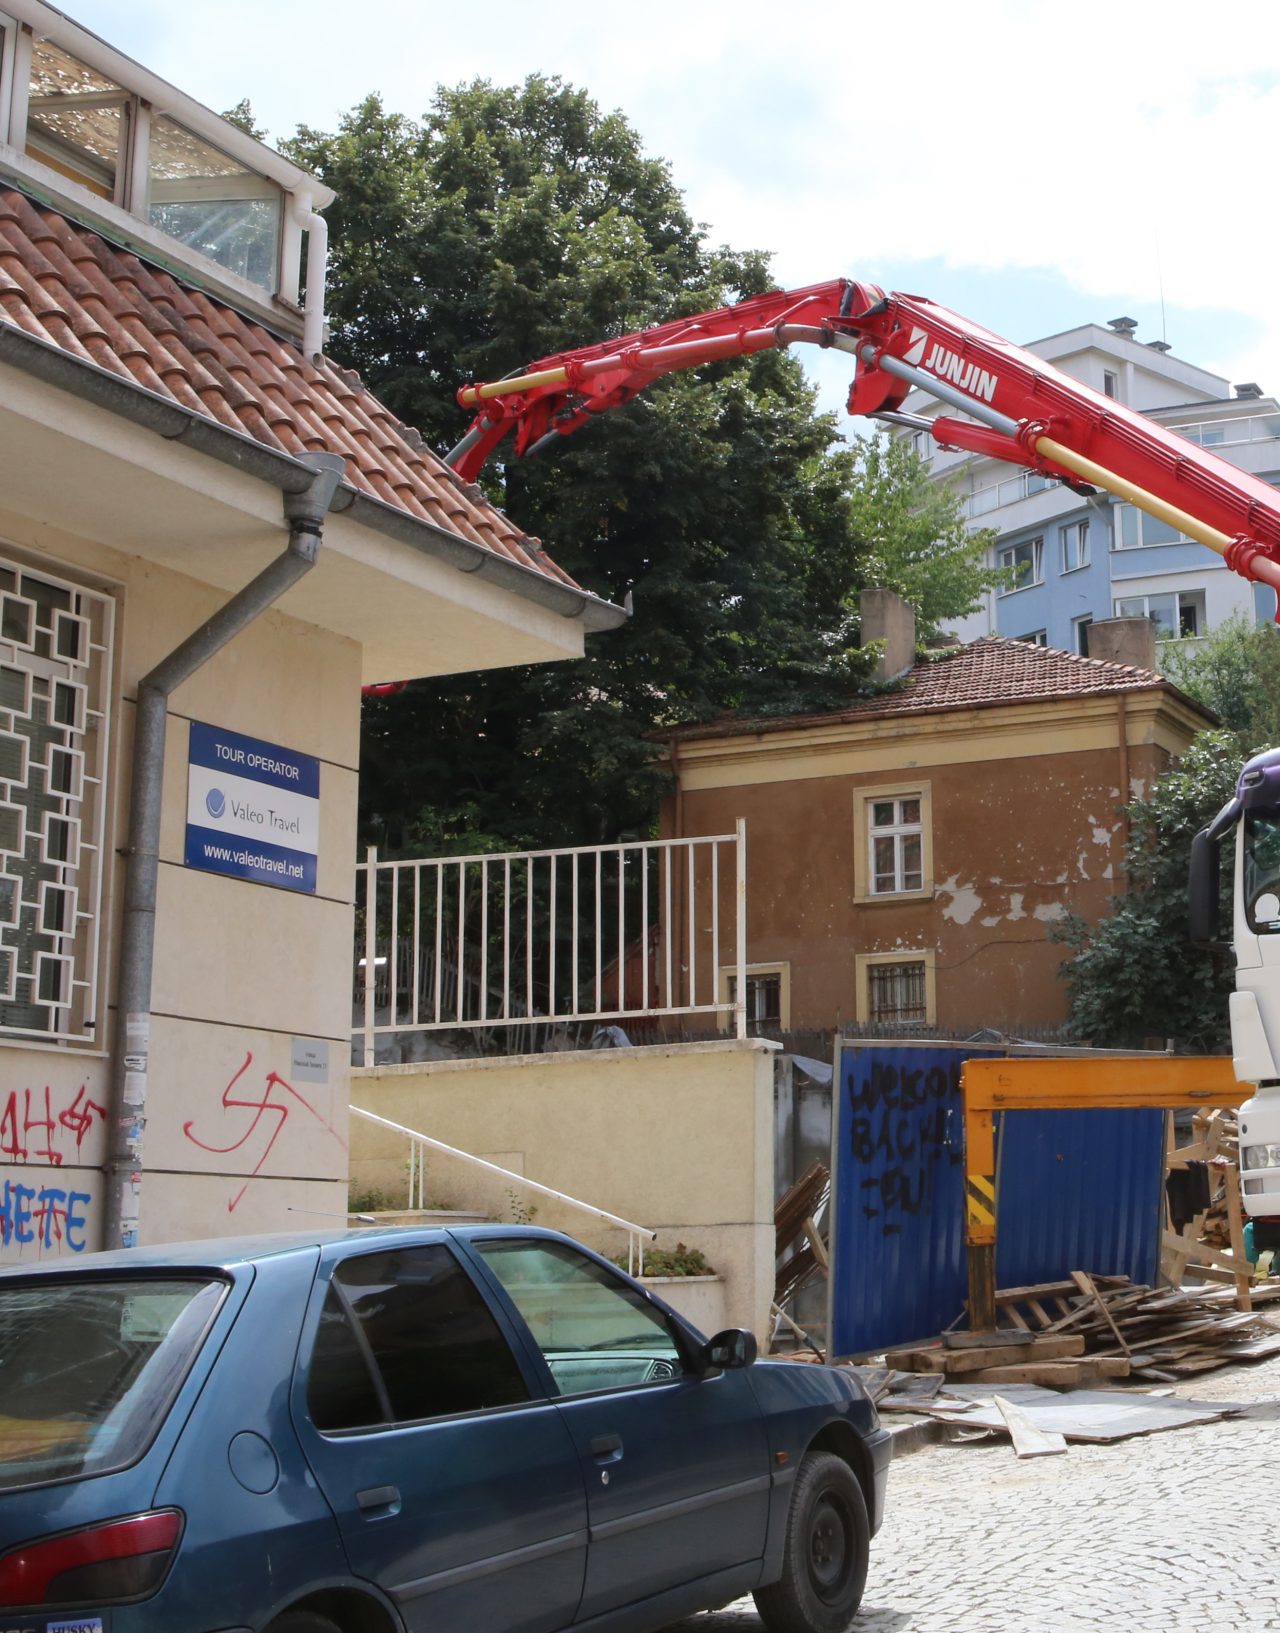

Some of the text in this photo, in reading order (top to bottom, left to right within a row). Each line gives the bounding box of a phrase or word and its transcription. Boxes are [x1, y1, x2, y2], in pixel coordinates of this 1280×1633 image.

[925, 343, 999, 402] JUNJIN
[215, 744, 300, 780] TOUR OPERATOR
[231, 799, 301, 834] Valeo Travel
[204, 844, 304, 879] www.valeotravel.net
